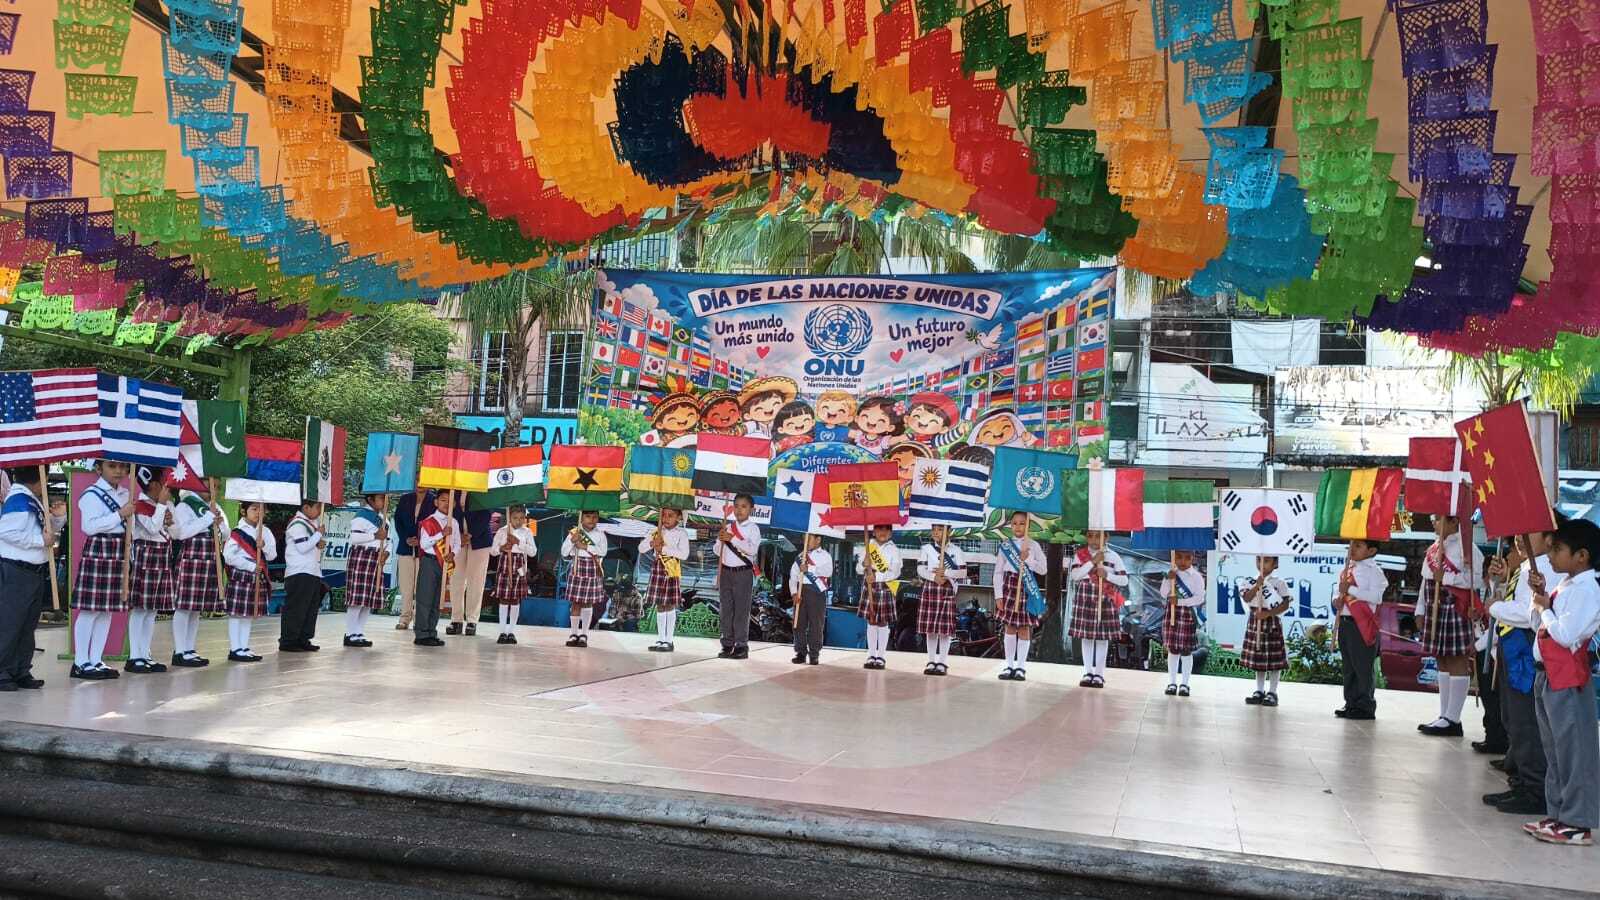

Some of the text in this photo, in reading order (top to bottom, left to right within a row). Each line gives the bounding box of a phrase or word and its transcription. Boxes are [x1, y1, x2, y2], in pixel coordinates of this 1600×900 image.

[698, 283, 991, 314] DÍA DE LAS NACIONES UNIDAS
[714, 314, 783, 335] Un mundo
[889, 317, 966, 341] Un futuro
[724, 328, 795, 347] más unido
[907, 334, 955, 353] mejor
[804, 358, 865, 376] ONU
[801, 455, 852, 468] Diferentes
[695, 501, 712, 511] Paz
[751, 508, 770, 518] idad
[871, 550, 888, 573] ESPA
